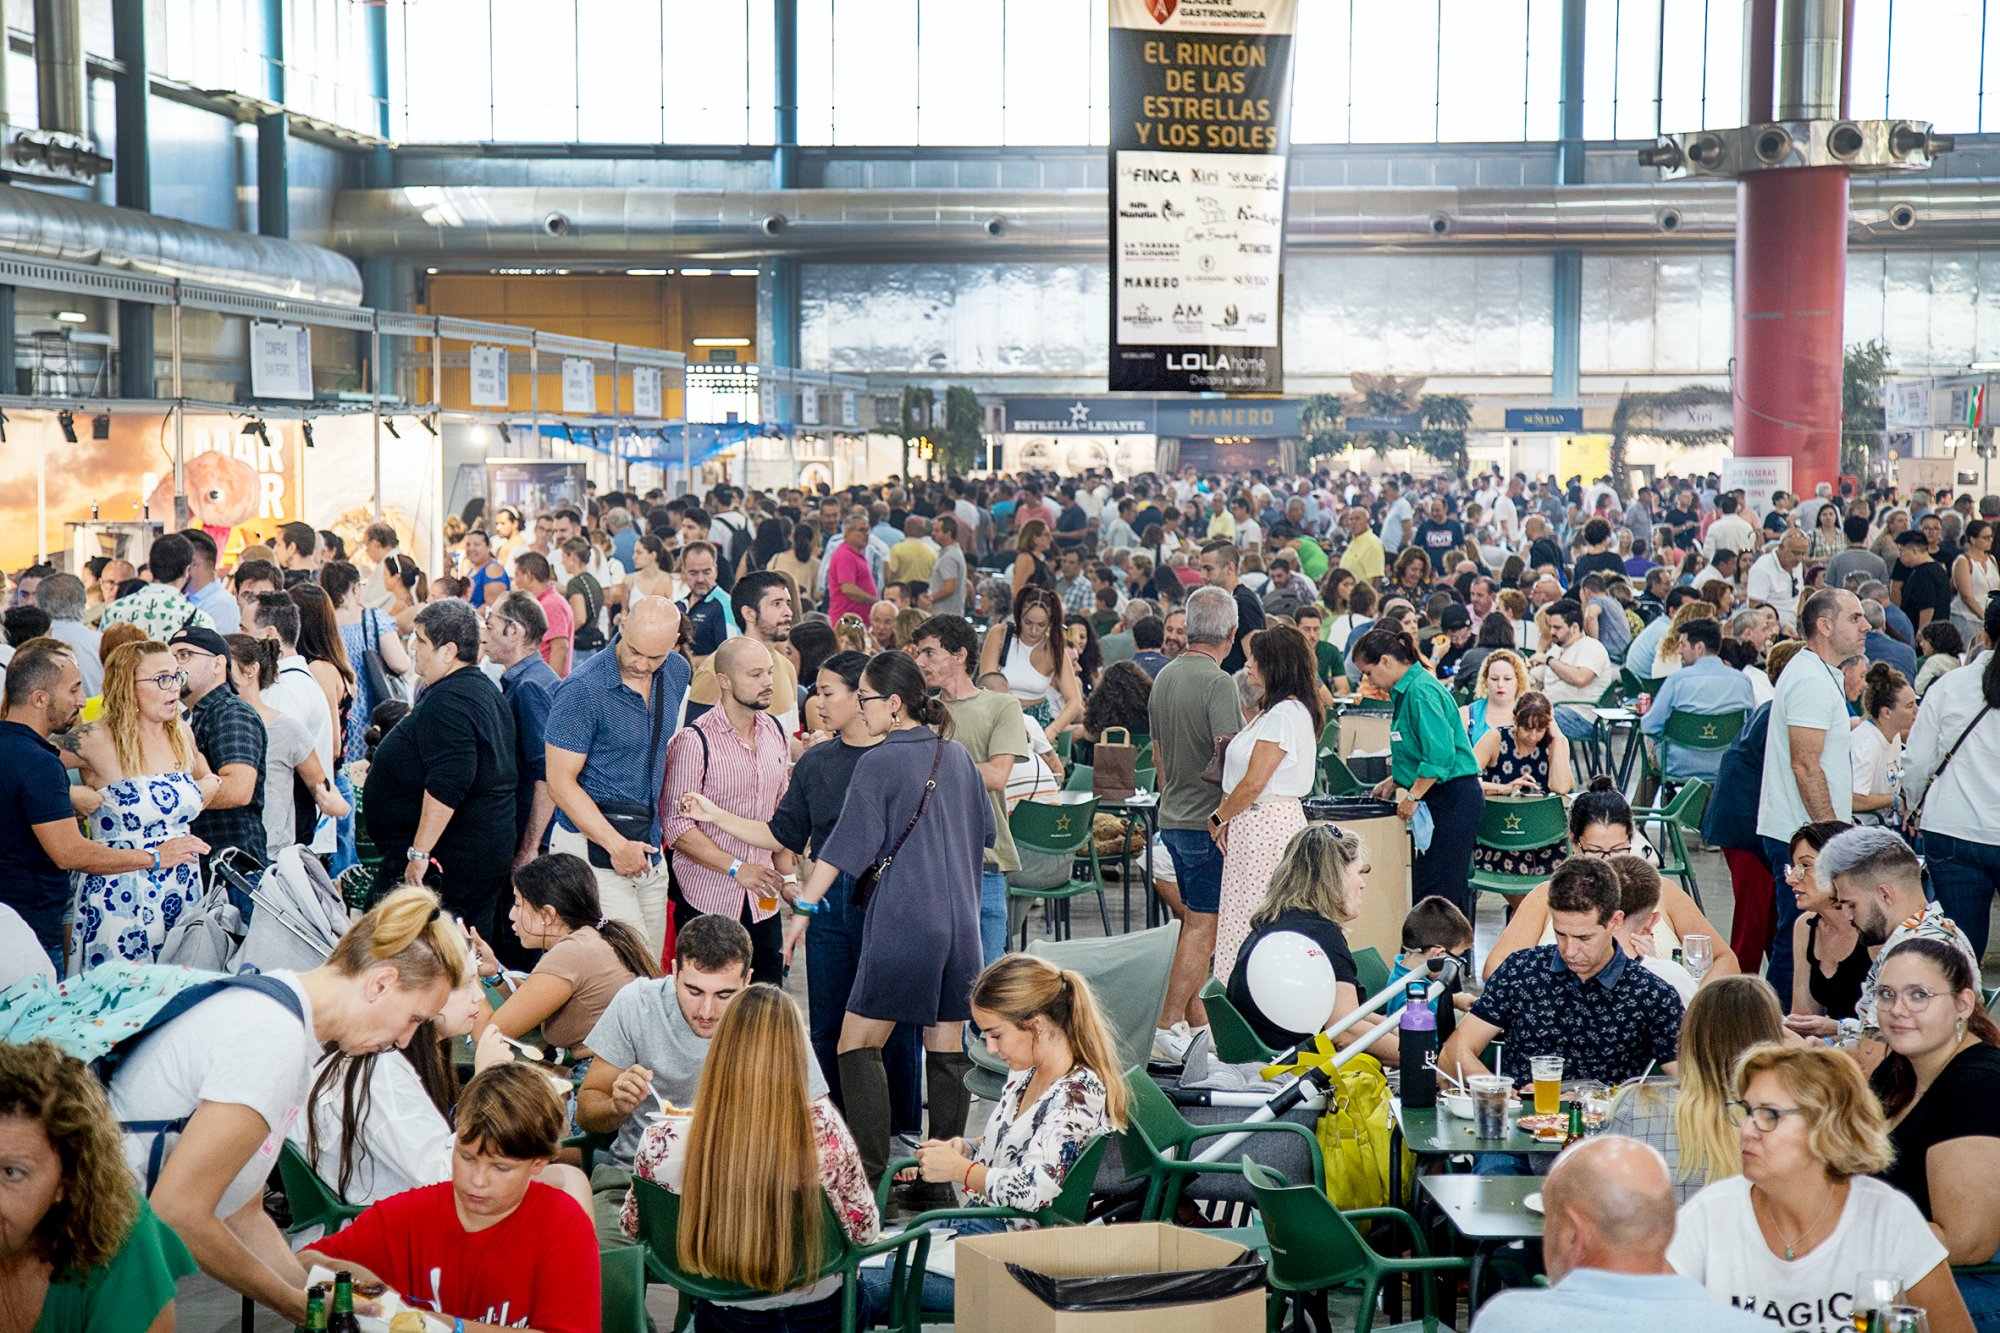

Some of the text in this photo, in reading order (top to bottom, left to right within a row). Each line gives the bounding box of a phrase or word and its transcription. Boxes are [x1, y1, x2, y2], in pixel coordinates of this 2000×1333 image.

[1144, 40, 1266, 67] EL RINCÓN
[1165, 69, 1246, 94] DE LAS
[1143, 95, 1271, 121] ESTRELLAS
[1135, 122, 1278, 149] Y LOS SOLES
[1133, 169, 1180, 183] FINCA
[1124, 277, 1180, 288] MANERO
[1166, 353, 1267, 372] LOLA home
[1014, 420, 1078, 431] ESTRELLA
[1088, 420, 1146, 431] LEVANTE
[1189, 408, 1274, 426] MANERO
[193, 427, 284, 472] MAR
